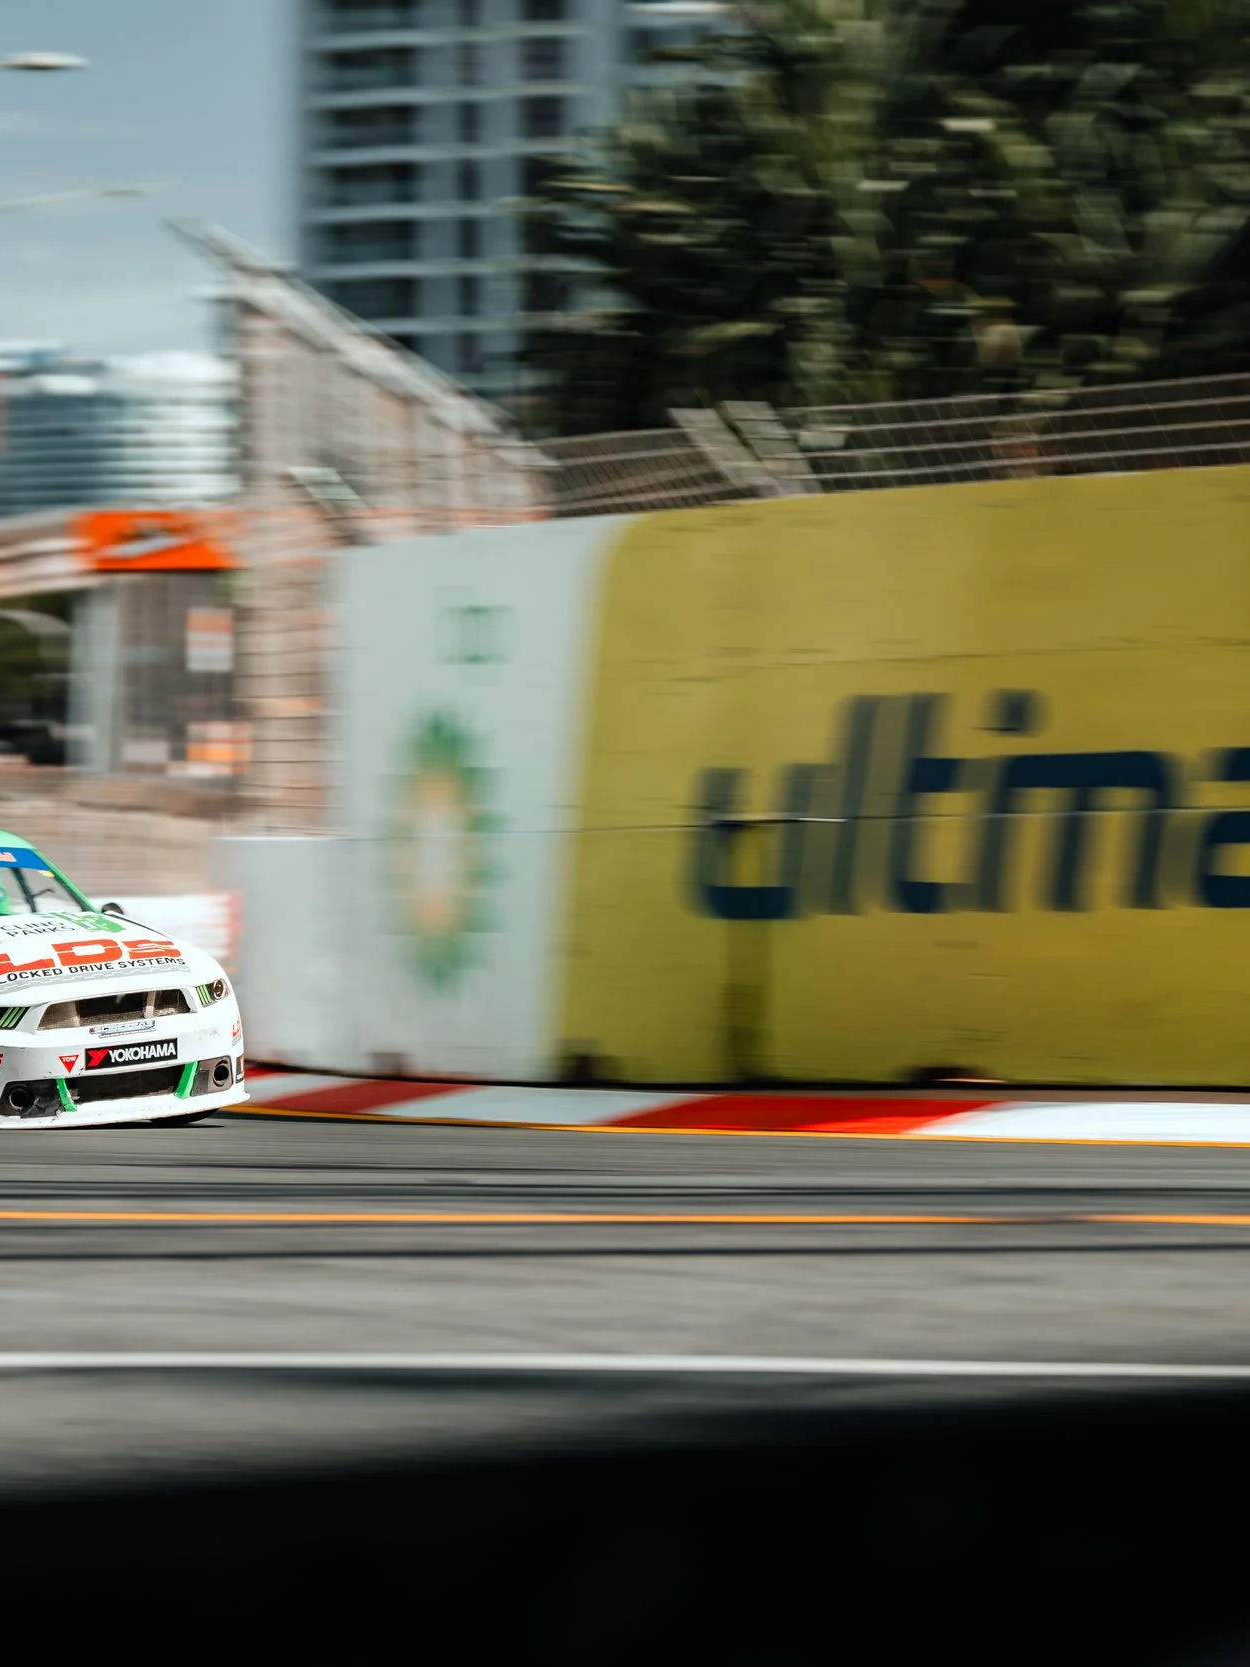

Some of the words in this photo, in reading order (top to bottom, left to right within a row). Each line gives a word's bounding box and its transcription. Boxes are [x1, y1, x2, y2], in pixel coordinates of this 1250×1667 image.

[6, 926, 76, 937] PARKS
[68, 962, 114, 975] DRIVE
[117, 957, 186, 969] SYSTEMS
[62, 1055, 78, 1063] TOW
[108, 1042, 177, 1063] YOKOHAMA
